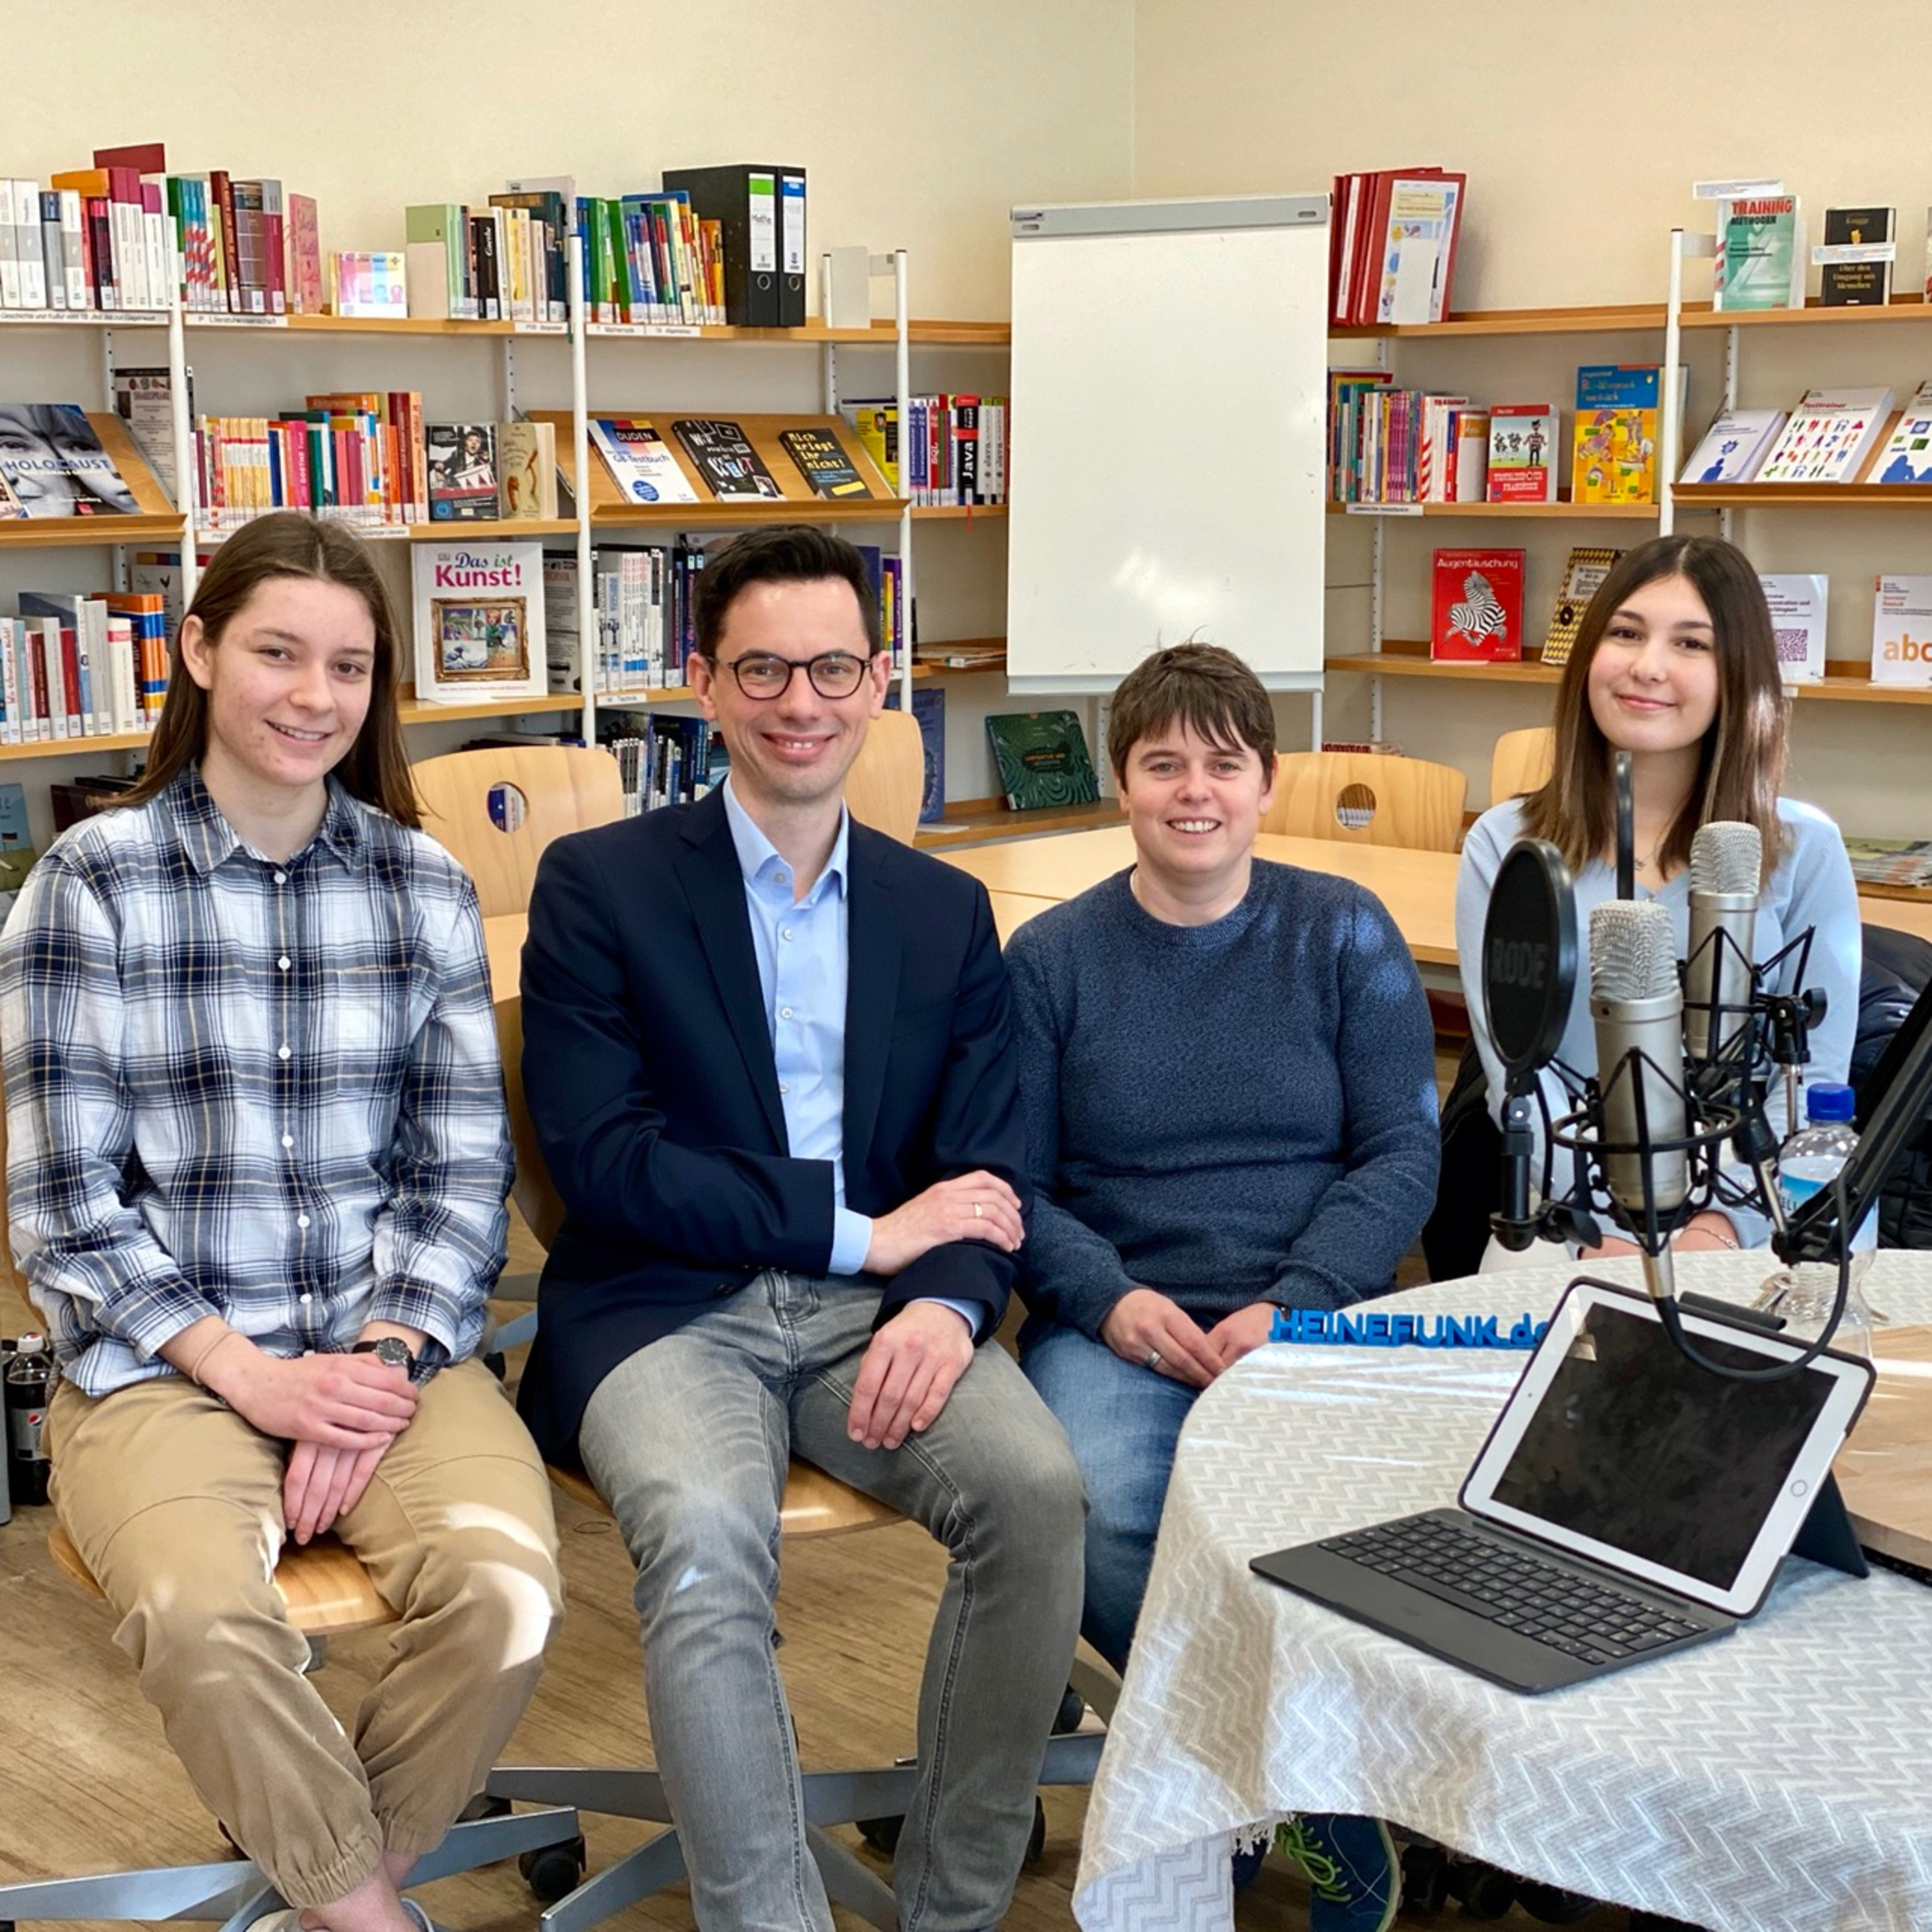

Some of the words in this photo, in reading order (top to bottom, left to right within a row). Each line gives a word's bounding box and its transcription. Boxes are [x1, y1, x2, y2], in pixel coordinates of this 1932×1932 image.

[1732, 200, 1792, 214] TRAINING
[1731, 216, 1777, 225] METHODEN
[616, 431, 653, 441] DUDEN
[788, 433, 817, 442] Mich
[793, 441, 835, 451] kriegt
[962, 442, 974, 479] Java
[983, 443, 992, 468] Java
[5, 459, 111, 471] HOLOCAUST
[806, 458, 845, 469] nicht!
[454, 552, 489, 569] Das
[493, 553, 514, 567] ist
[435, 563, 522, 588] Kunst!
[1883, 634, 1932, 663] abc
